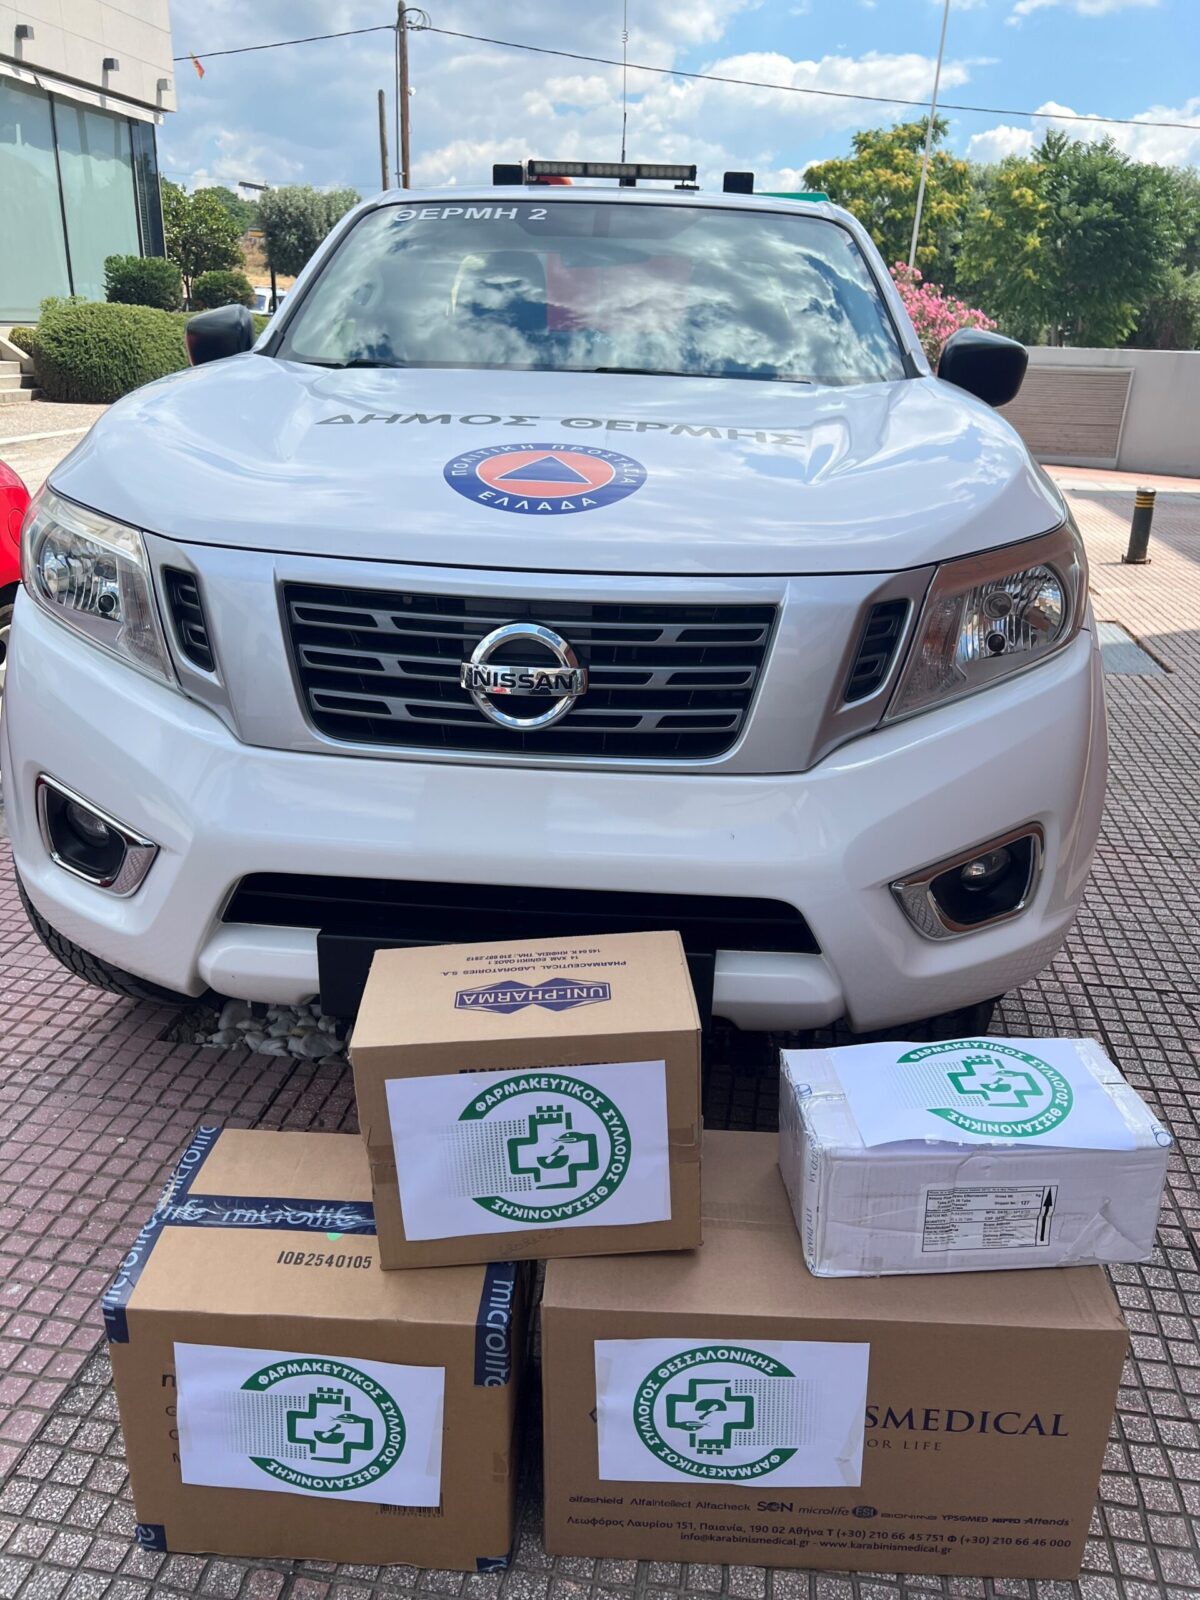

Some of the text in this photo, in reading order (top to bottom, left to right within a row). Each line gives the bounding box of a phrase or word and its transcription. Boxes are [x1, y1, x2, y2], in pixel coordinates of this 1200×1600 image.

[393, 208, 547, 221] ΘΕΡΜΗ 2
[315, 413, 806, 447] ΔΗΜΟΣ ΘΕΡΜΗΣ
[452, 444, 640, 484] ΠΟΛΙΤΙΚΗ ΠΡΟΣΤΑΣΙΑ
[478, 490, 597, 511] ΕΛΛΑΔΑ
[472, 669, 574, 690] NISSAN
[463, 966, 536, 975] LABORATORIES
[540, 960, 627, 970] PHARMACEUTICAL
[463, 986, 604, 1004] UNI-PHARMA
[475, 1077, 604, 1112] ΦΑΡΜΑΚΕΥΤΙΚΟΣ
[910, 1042, 1068, 1135] ΦΑΡΜΑΚΕΥΤΙΚΟΣ ΣΥΛΛΟΓΟΣ ΘΕΣΣΑΛΟΝΙΚΗΣ
[602, 1109, 627, 1183] ΣΥΛΛΟΓΟΣ
[491, 1185, 609, 1220] ΘΕΣΣΑΛΟΝΙΚΗΣ
[258, 1361, 402, 1488] ΦΑΡΜΑΚΕΥΤΙΚΟΣ ΣΥΛΛΟΓΟΣ ΘΕΣΣΑΛΟΝΙΚΗΣ
[638, 1349, 781, 1478] ΘΕΣΣΑΛΟΝΙΚΗΣ ΣΥΛΛΟΓΟΣ ΦΑΡΜΑΚΕΥΤΙΚΟΣ
[865, 1405, 1069, 1437] SMEDICAL
[866, 1438, 942, 1451] OR LIFE
[799, 1506, 849, 1516] microlife
[567, 1516, 624, 1527] Λεωφόρος
[627, 1519, 673, 1529] Λαυρίου
[677, 1522, 696, 1531] 151,
[700, 1523, 746, 1533] Παιανία,
[750, 1525, 769, 1533] 190
[772, 1526, 785, 1534] 02
[788, 1527, 823, 1537] Αθήνα
[837, 1529, 866, 1539] (+30)
[869, 1531, 888, 1539] 210
[891, 1532, 905, 1540] 66
[909, 1533, 922, 1541] 45
[926, 1534, 944, 1542] 751
[960, 1535, 990, 1545] (+30)
[992, 1537, 1012, 1545] 210
[1015, 1538, 1029, 1546] 66
[1049, 1539, 1071, 1548] 000
[680, 1532, 809, 1547] info@karabinismedical.gr
[819, 1541, 952, 1555] www.karabinismedical.gr
